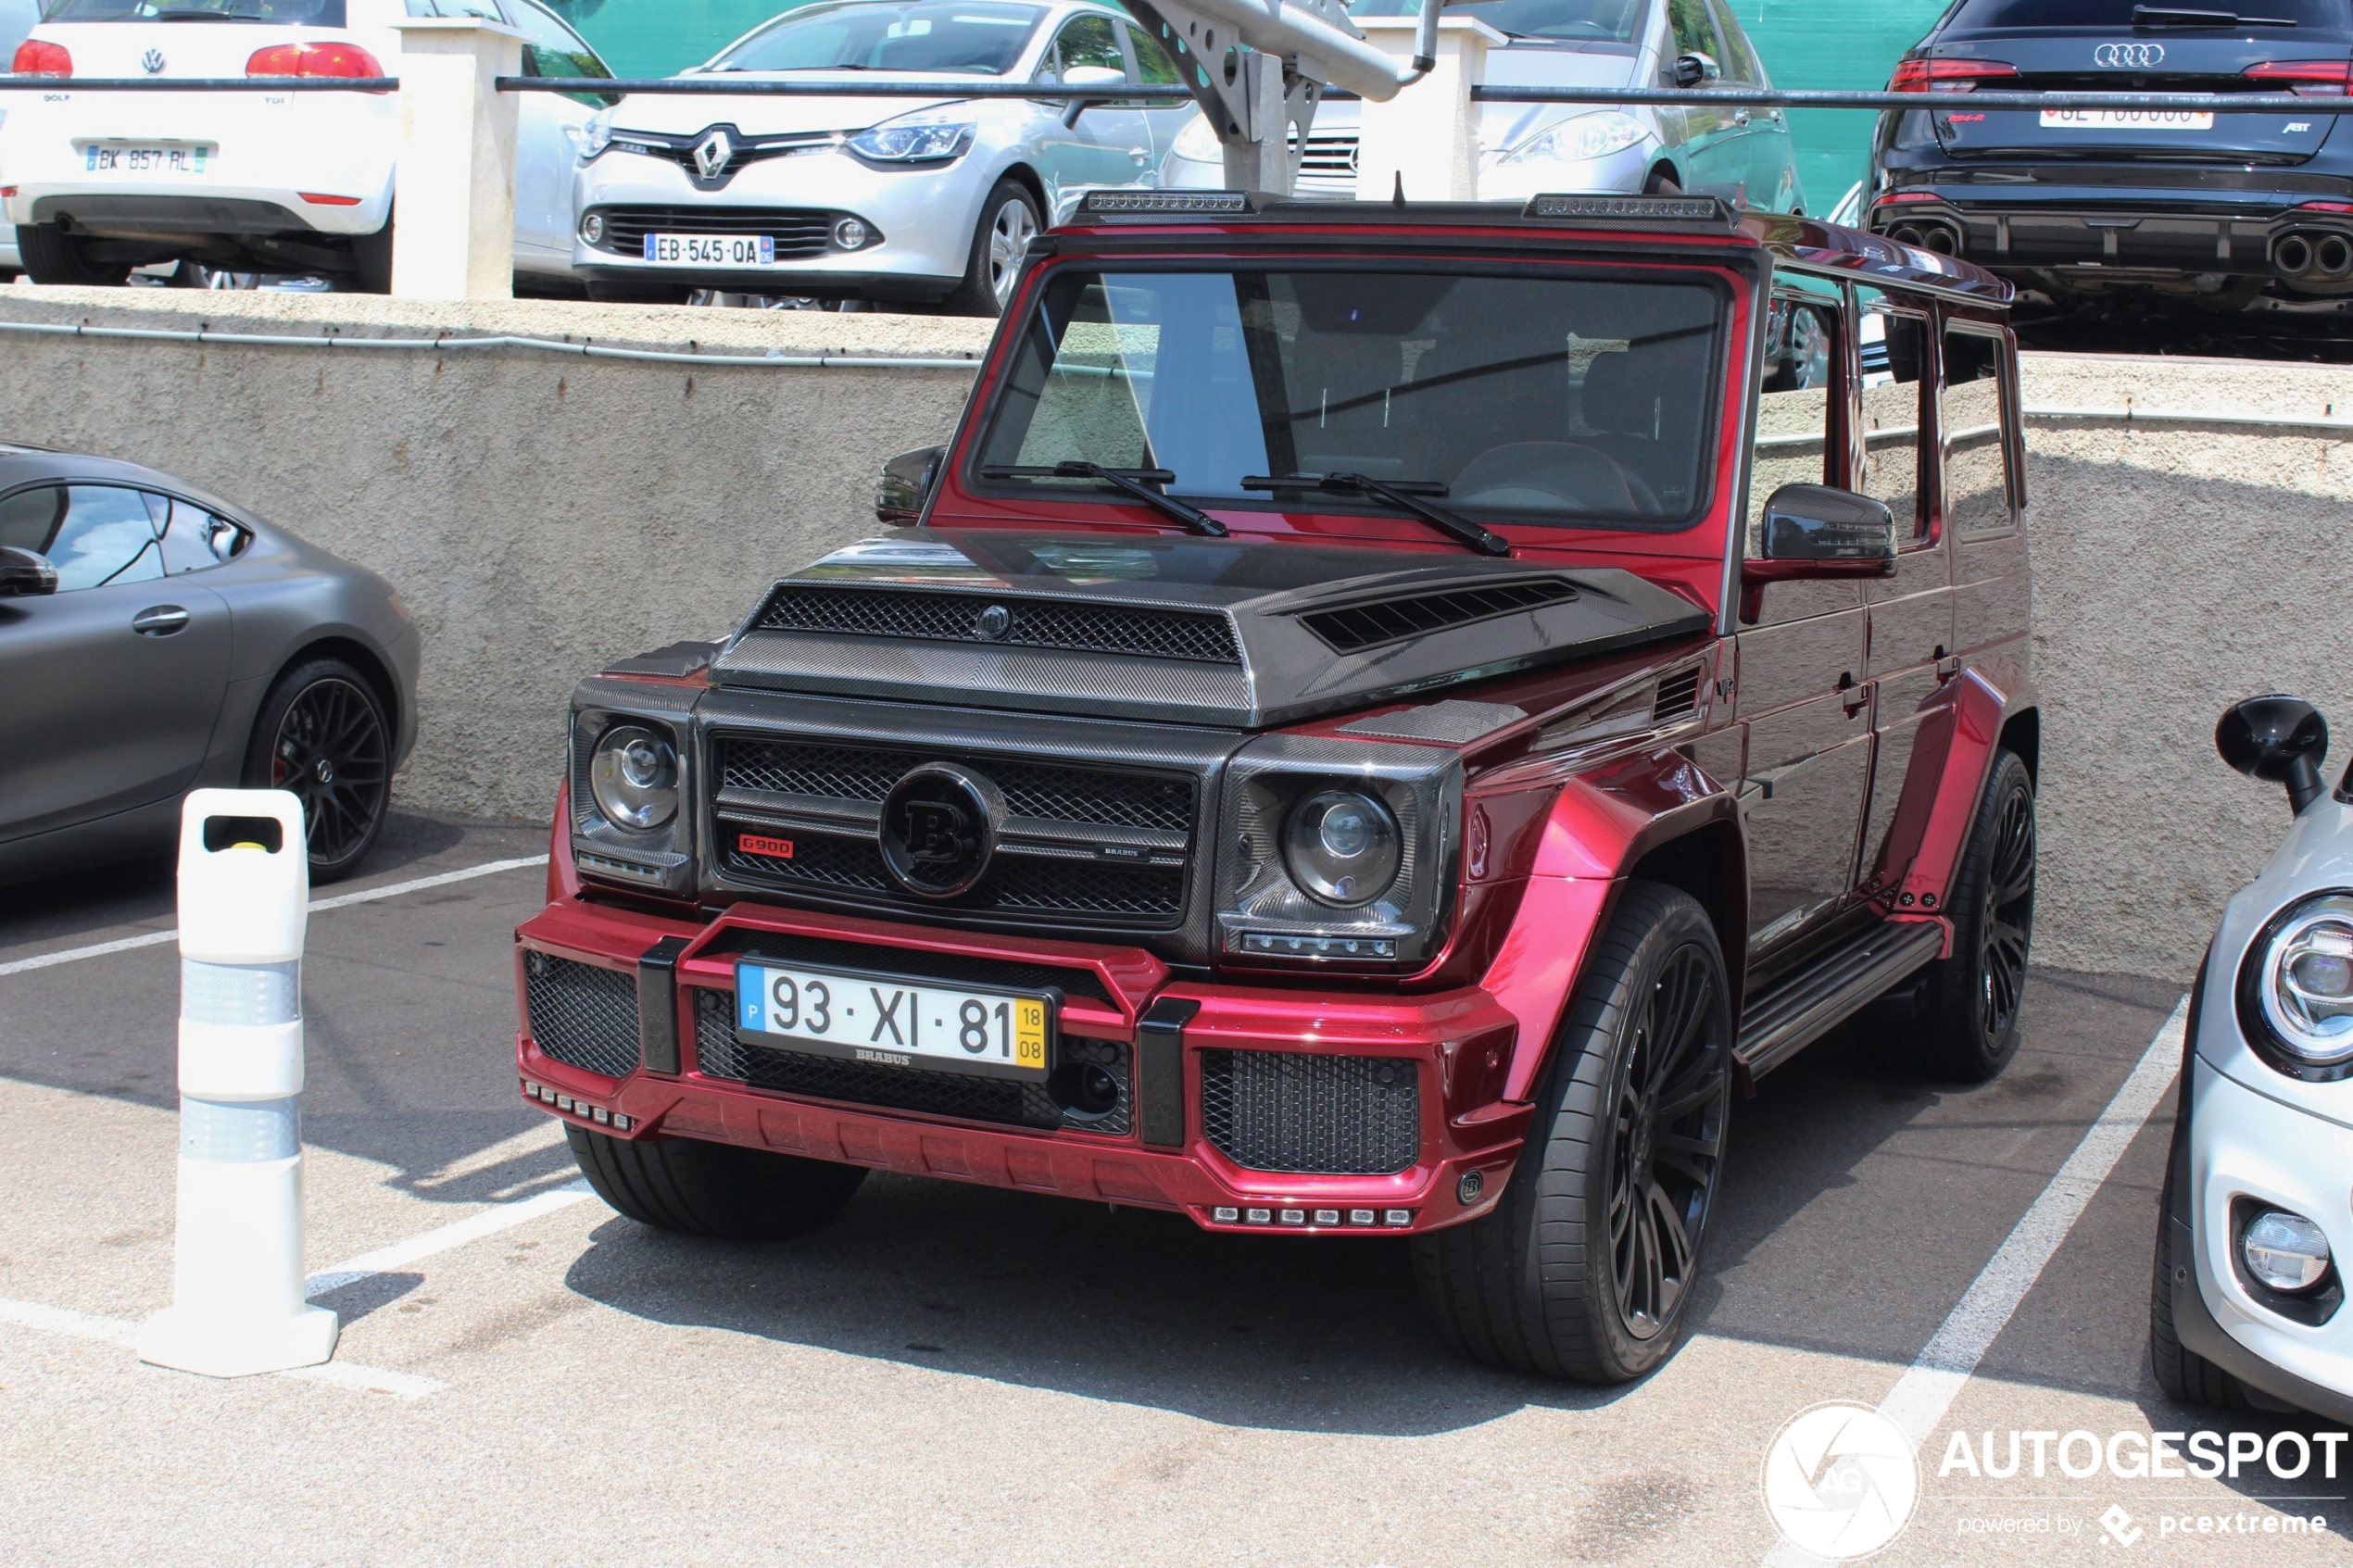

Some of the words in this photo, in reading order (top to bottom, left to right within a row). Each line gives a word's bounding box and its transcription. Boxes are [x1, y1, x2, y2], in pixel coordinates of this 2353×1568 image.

[2282, 122, 2311, 133] ABT
[1104, 847, 1139, 857] BRABUS
[749, 1004, 759, 1019] P
[1024, 1007, 1040, 1026] 18
[856, 1048, 910, 1066] BRABUS
[1020, 1040, 1041, 1060] 08
